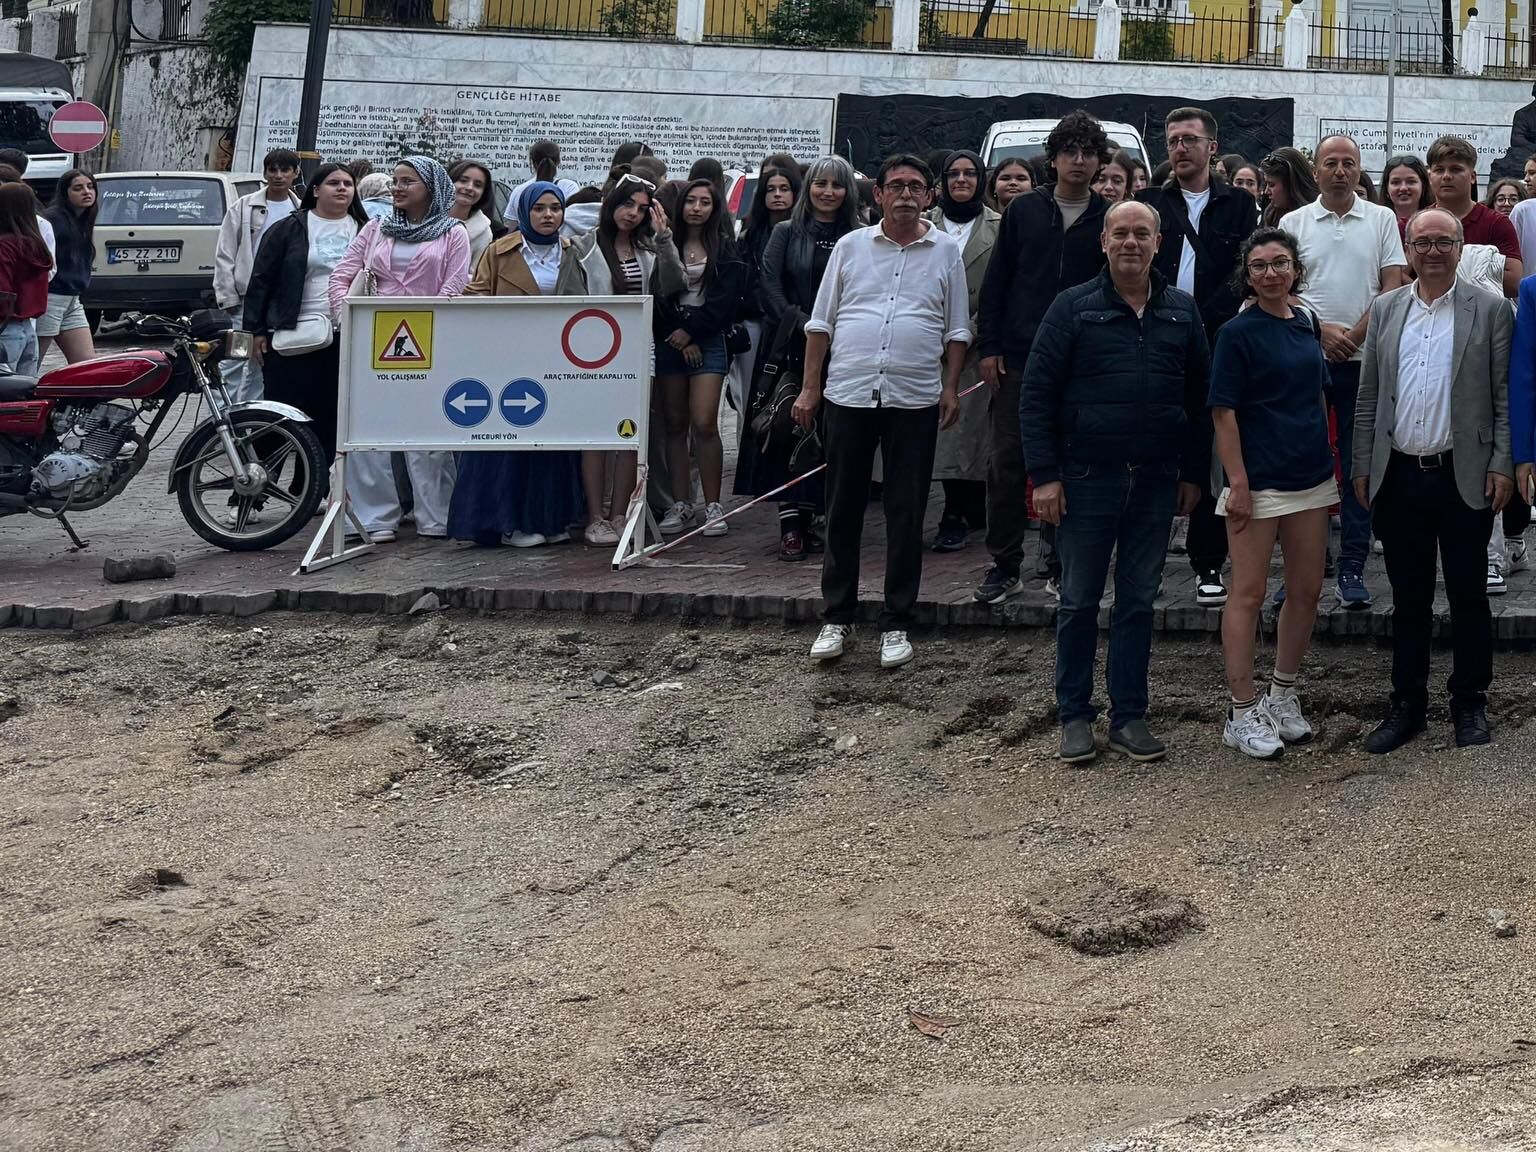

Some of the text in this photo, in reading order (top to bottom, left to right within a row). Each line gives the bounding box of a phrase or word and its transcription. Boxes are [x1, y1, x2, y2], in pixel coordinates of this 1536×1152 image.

[457, 90, 561, 102] GENÇLİĞE HİTABE
[333, 105, 361, 113] gençliği
[576, 113, 609, 121] muhafaza
[622, 114, 651, 122] müdafaa
[318, 130, 379, 139] üşünmeyeceksin!
[1325, 127, 1359, 137] Türkiye
[1362, 128, 1434, 139] Cumhriyeti'nin
[115, 249, 177, 259] 45 ZZ 210
[391, 373, 427, 381] ÇALIŞMASI
[543, 373, 562, 381] ARAÇ
